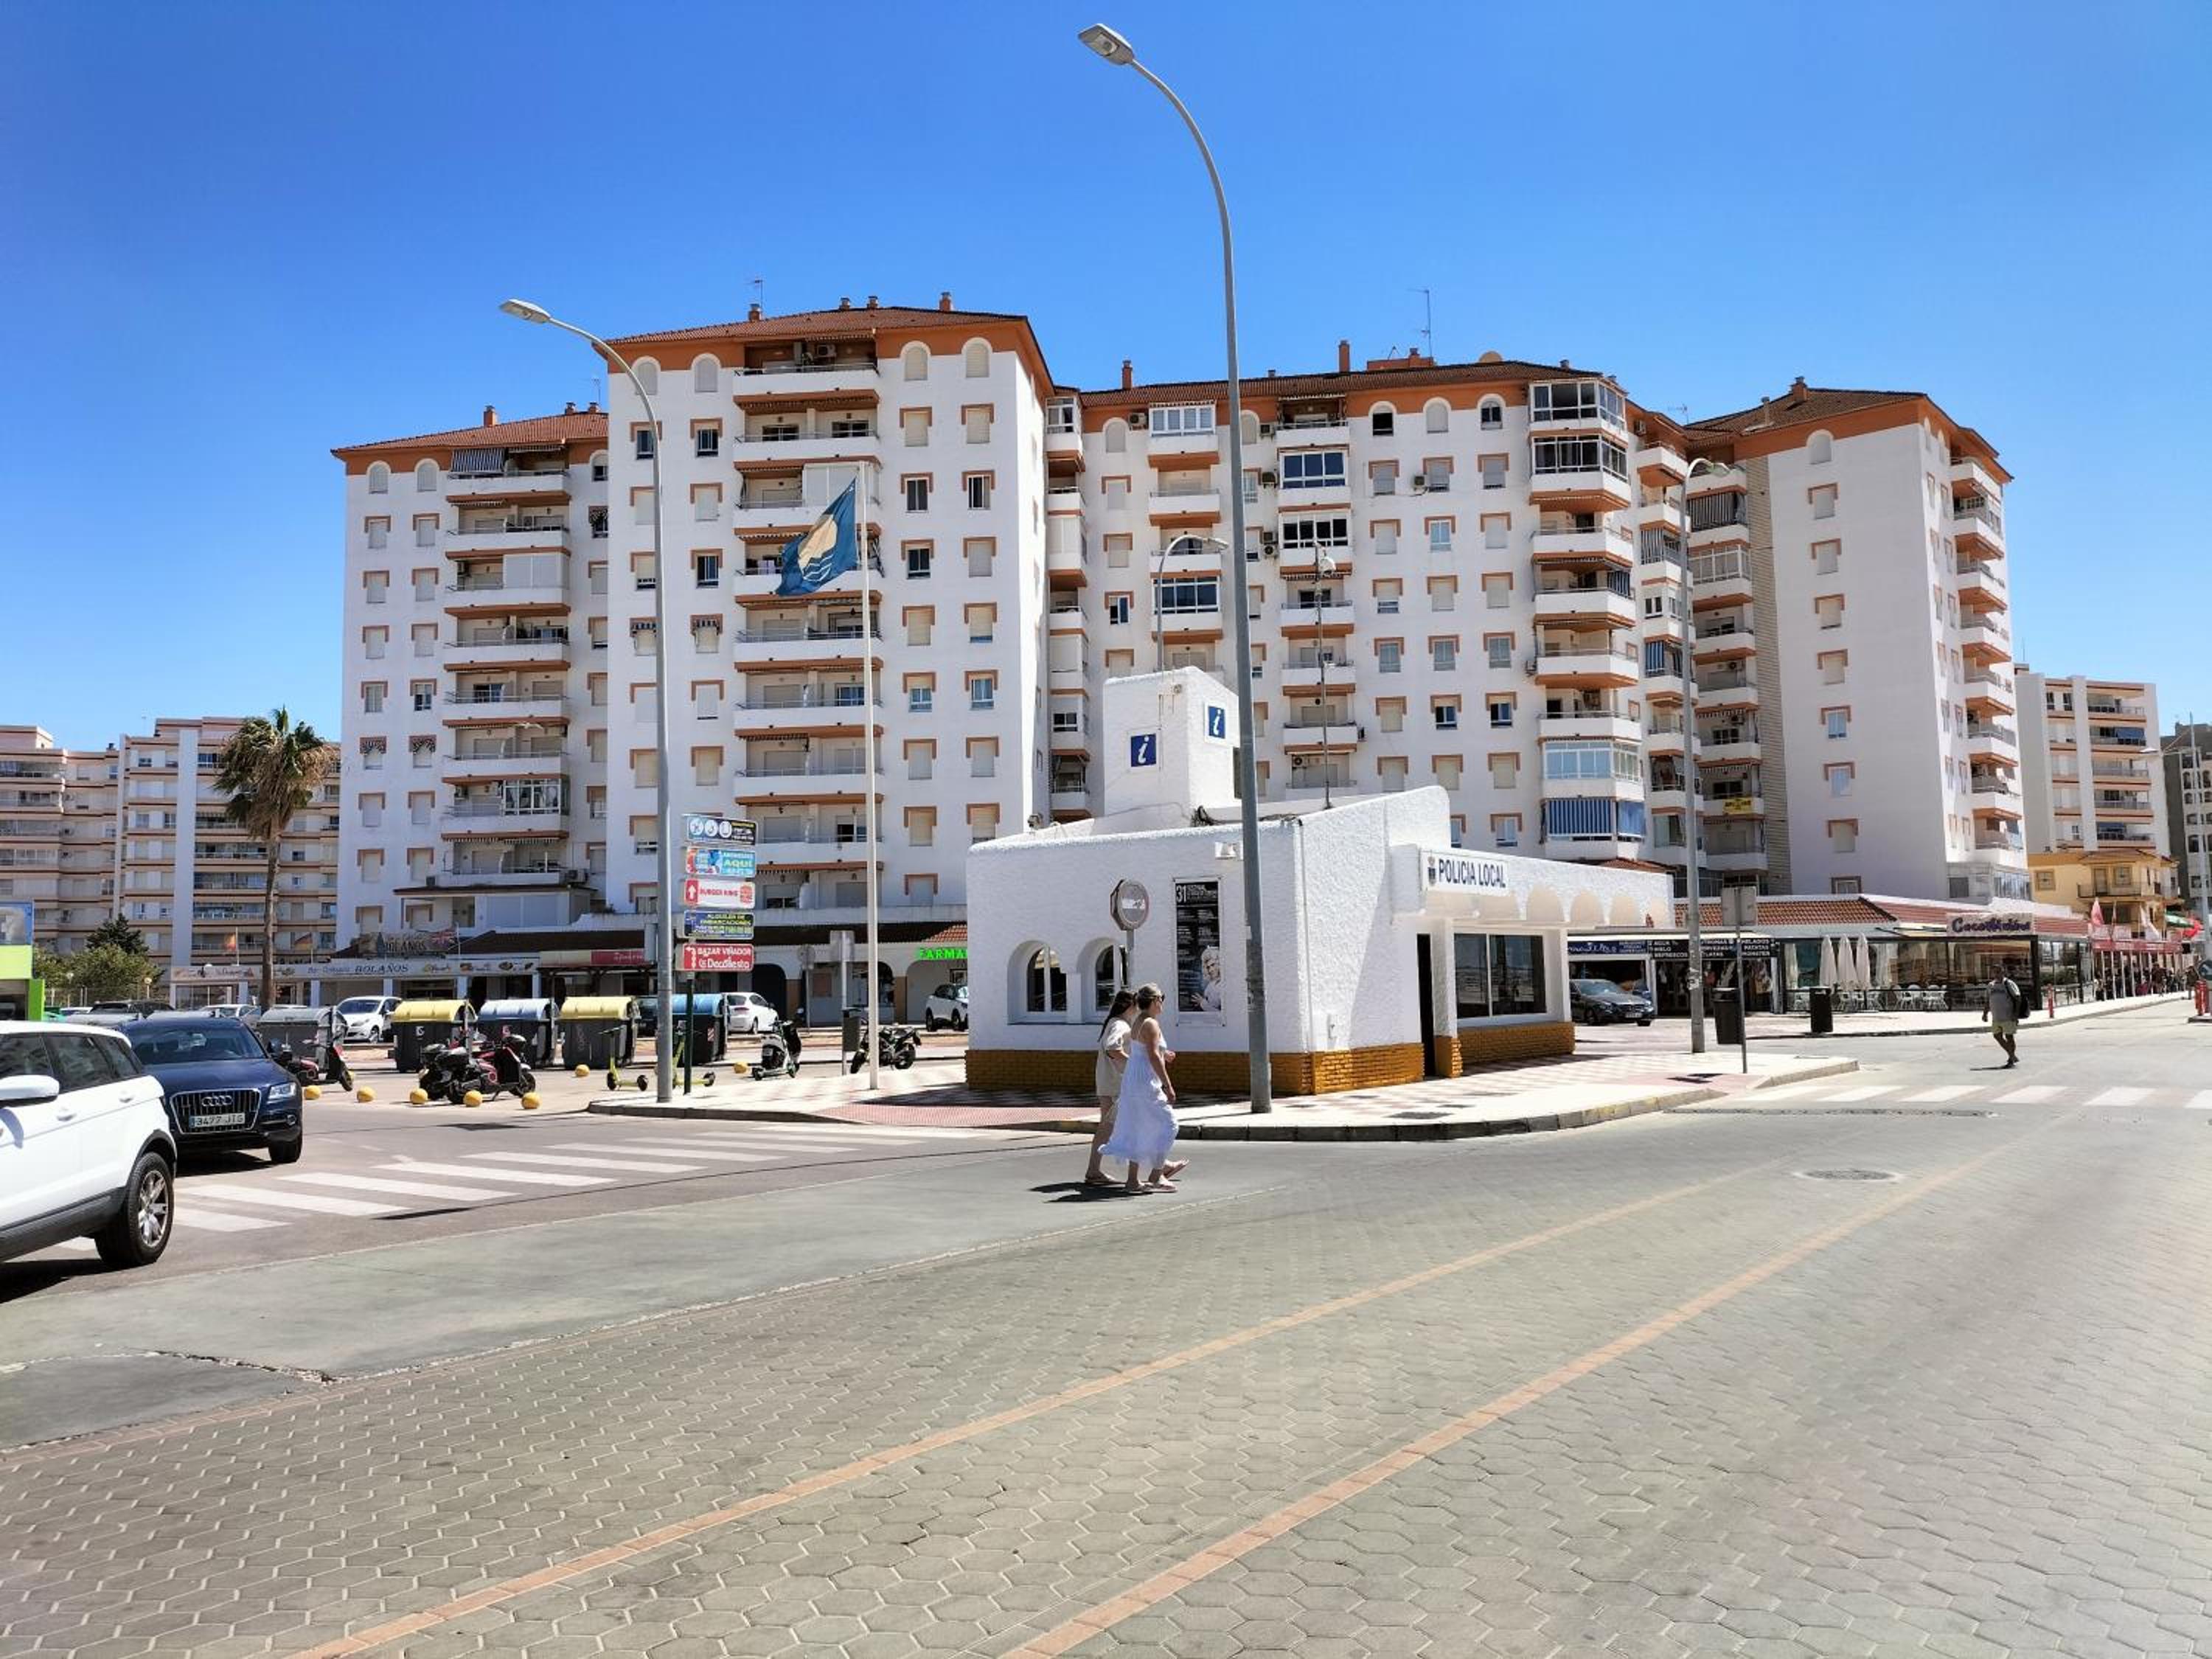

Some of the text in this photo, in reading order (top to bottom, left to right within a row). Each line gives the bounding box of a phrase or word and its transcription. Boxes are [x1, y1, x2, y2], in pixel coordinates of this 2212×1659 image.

[1138, 736, 1150, 764] i
[1478, 863, 1506, 888] LOCAL
[1176, 885, 1186, 902] 31
[919, 948, 967, 959] FARMA
